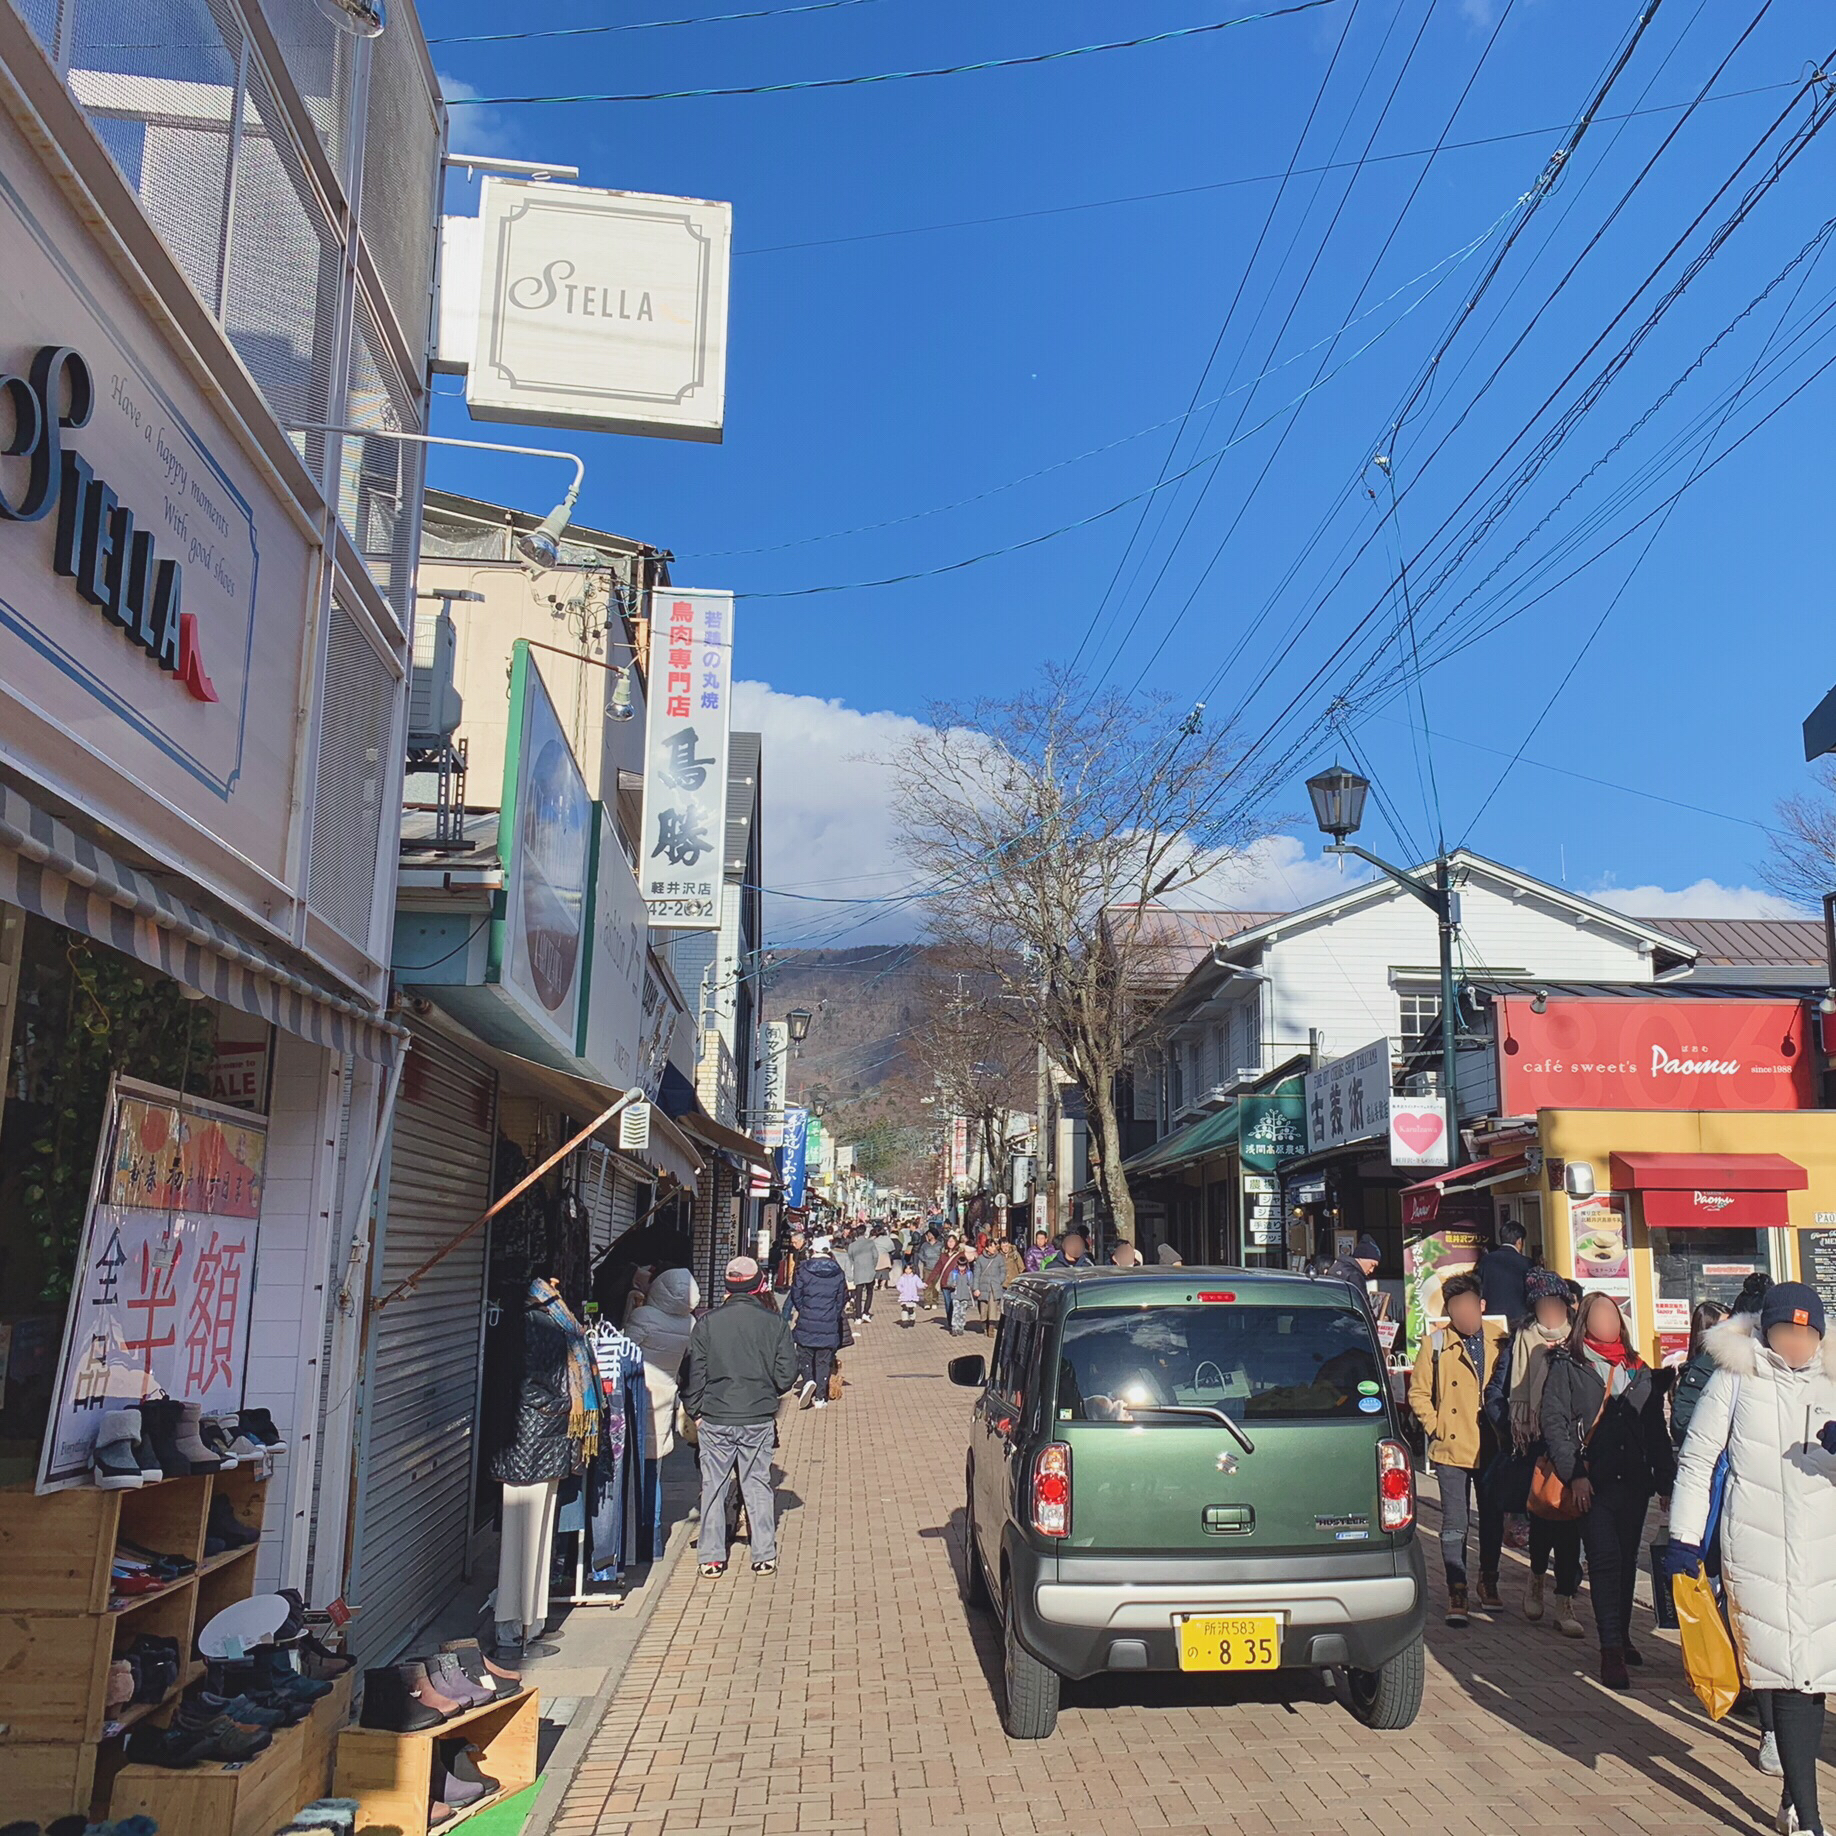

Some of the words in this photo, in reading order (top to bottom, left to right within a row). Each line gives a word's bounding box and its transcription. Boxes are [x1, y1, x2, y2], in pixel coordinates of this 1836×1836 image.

[508, 259, 654, 322] STELLA
[110, 374, 142, 428] Have
[145, 423, 153, 442] a
[156, 427, 188, 496] happy
[190, 478, 230, 538] moments
[0, 345, 183, 672] STELLA
[163, 496, 188, 543] With
[189, 533, 212, 570] good
[215, 560, 236, 597] shoes
[666, 601, 694, 718] 鳥肉専門店
[701, 611, 723, 710] 若鶏の丸焼
[651, 881, 711, 895] 軽井沢店
[210, 1072, 257, 1098] ALE
[245, 1060, 256, 1068] to
[1522, 1059, 1563, 1073] café
[1571, 1060, 1638, 1073] sweet's
[1650, 1044, 1740, 1078] Paomu
[1245, 1144, 1306, 1155] 浅間高原農場
[1693, 1191, 1735, 1206] Paomu
[73, 1227, 127, 1414] 全品
[120, 1230, 246, 1408] 半額
